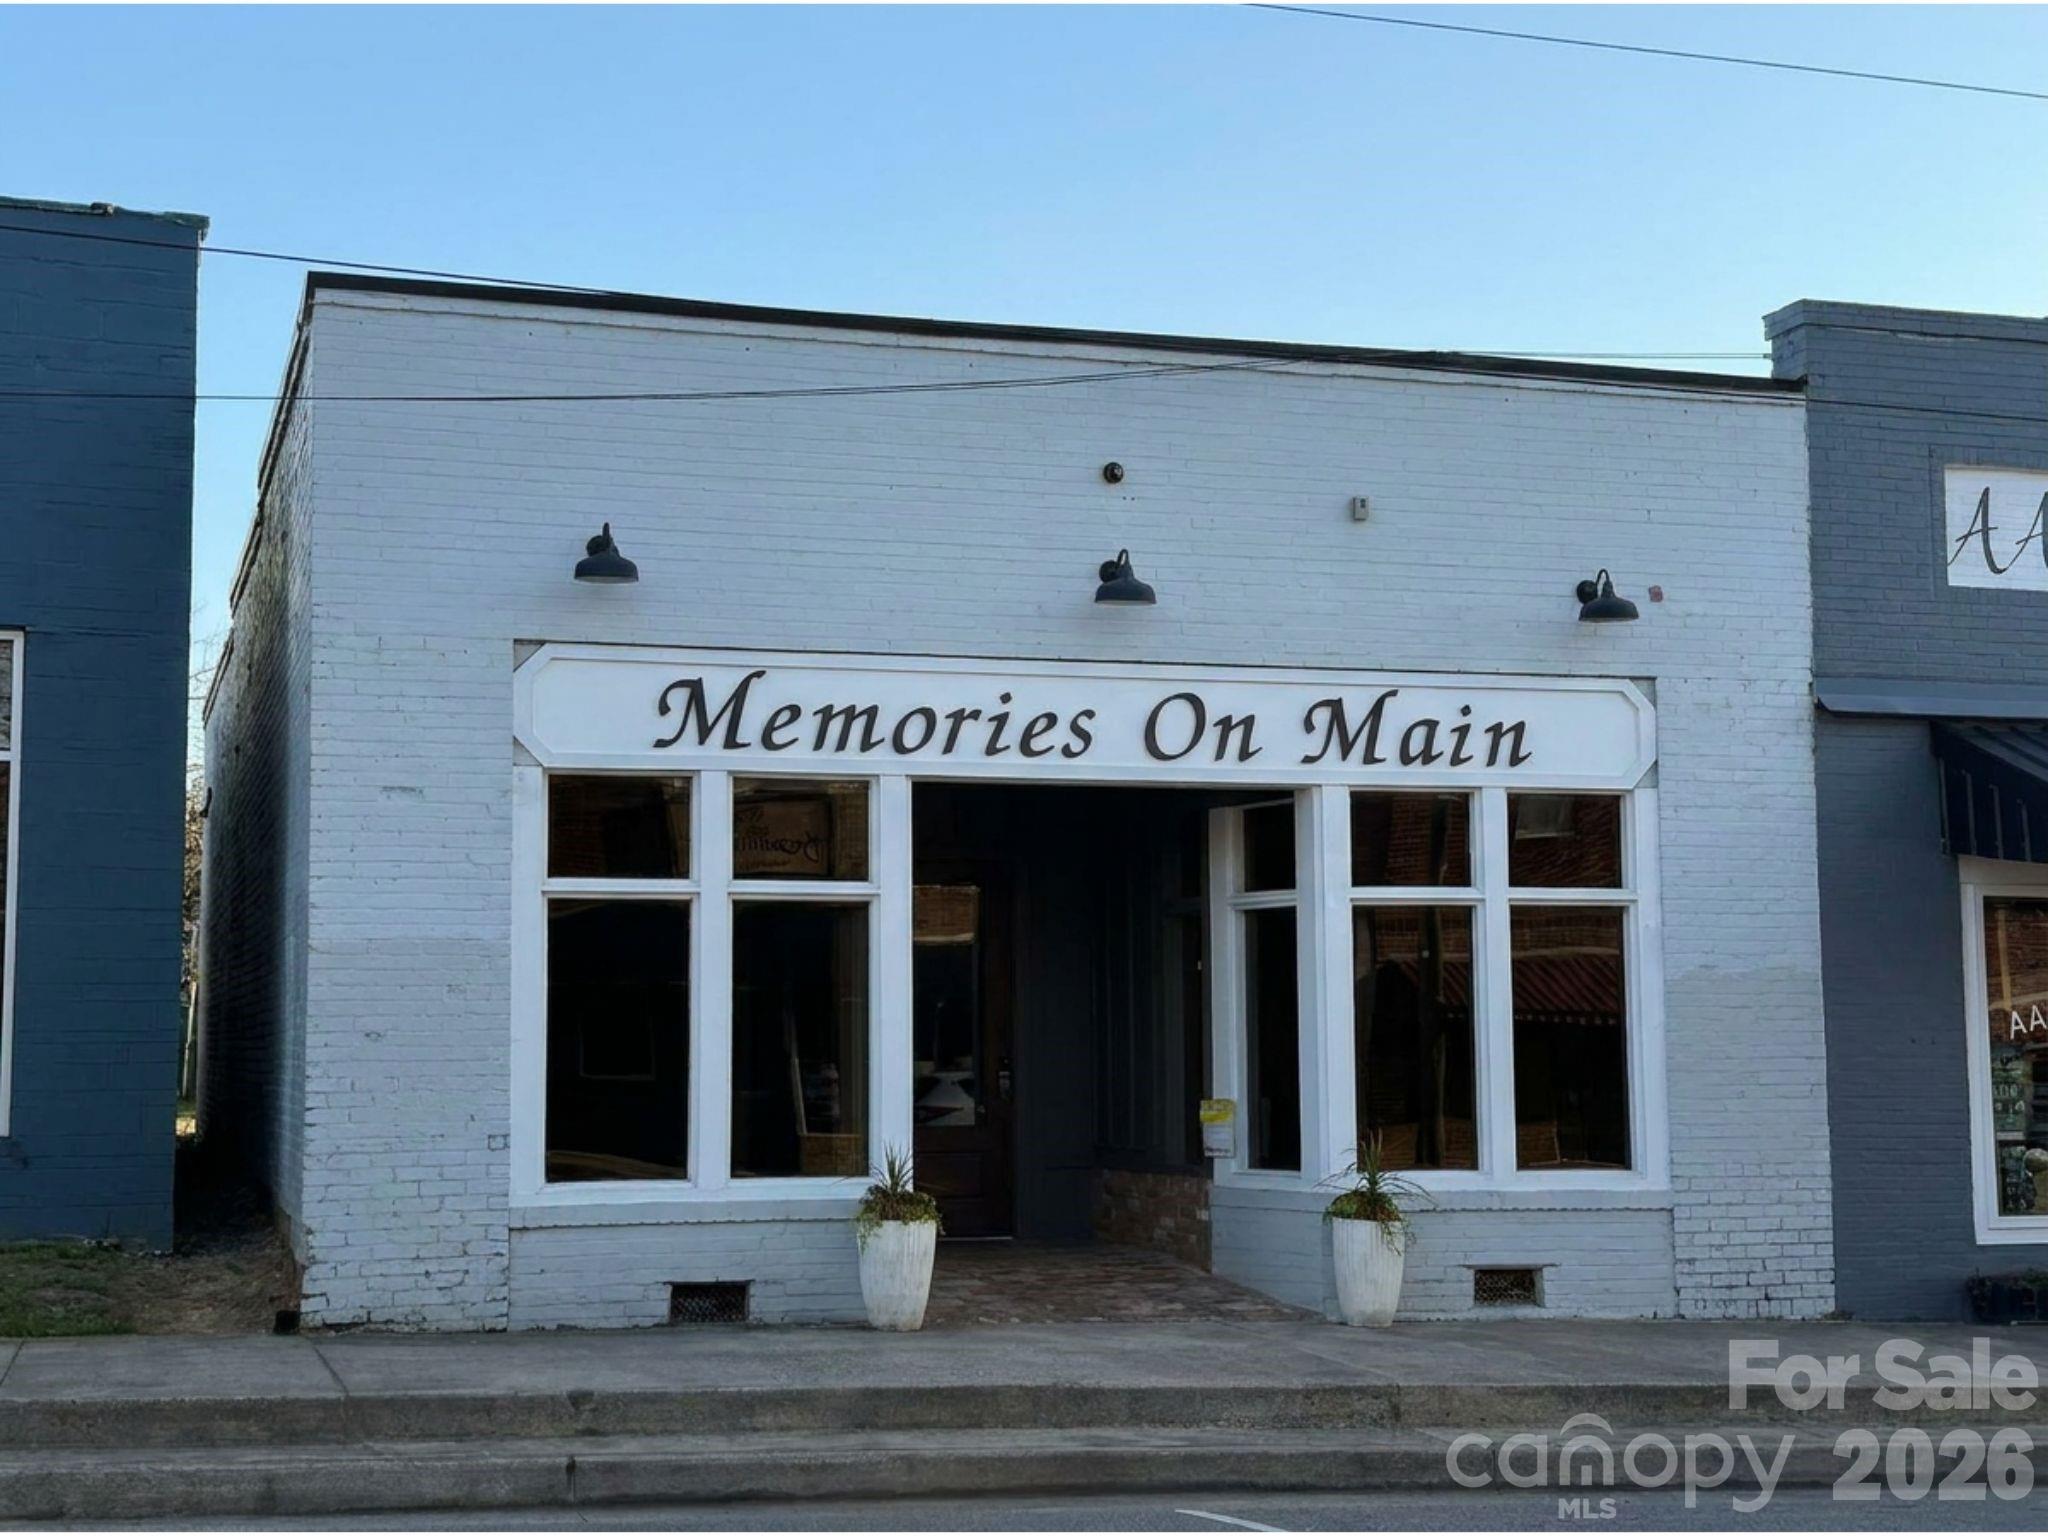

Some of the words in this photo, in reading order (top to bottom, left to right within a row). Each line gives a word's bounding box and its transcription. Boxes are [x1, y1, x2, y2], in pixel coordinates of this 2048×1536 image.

[652, 669, 1096, 759] Memories
[1143, 692, 1263, 763] On
[1301, 689, 1533, 767] Main
